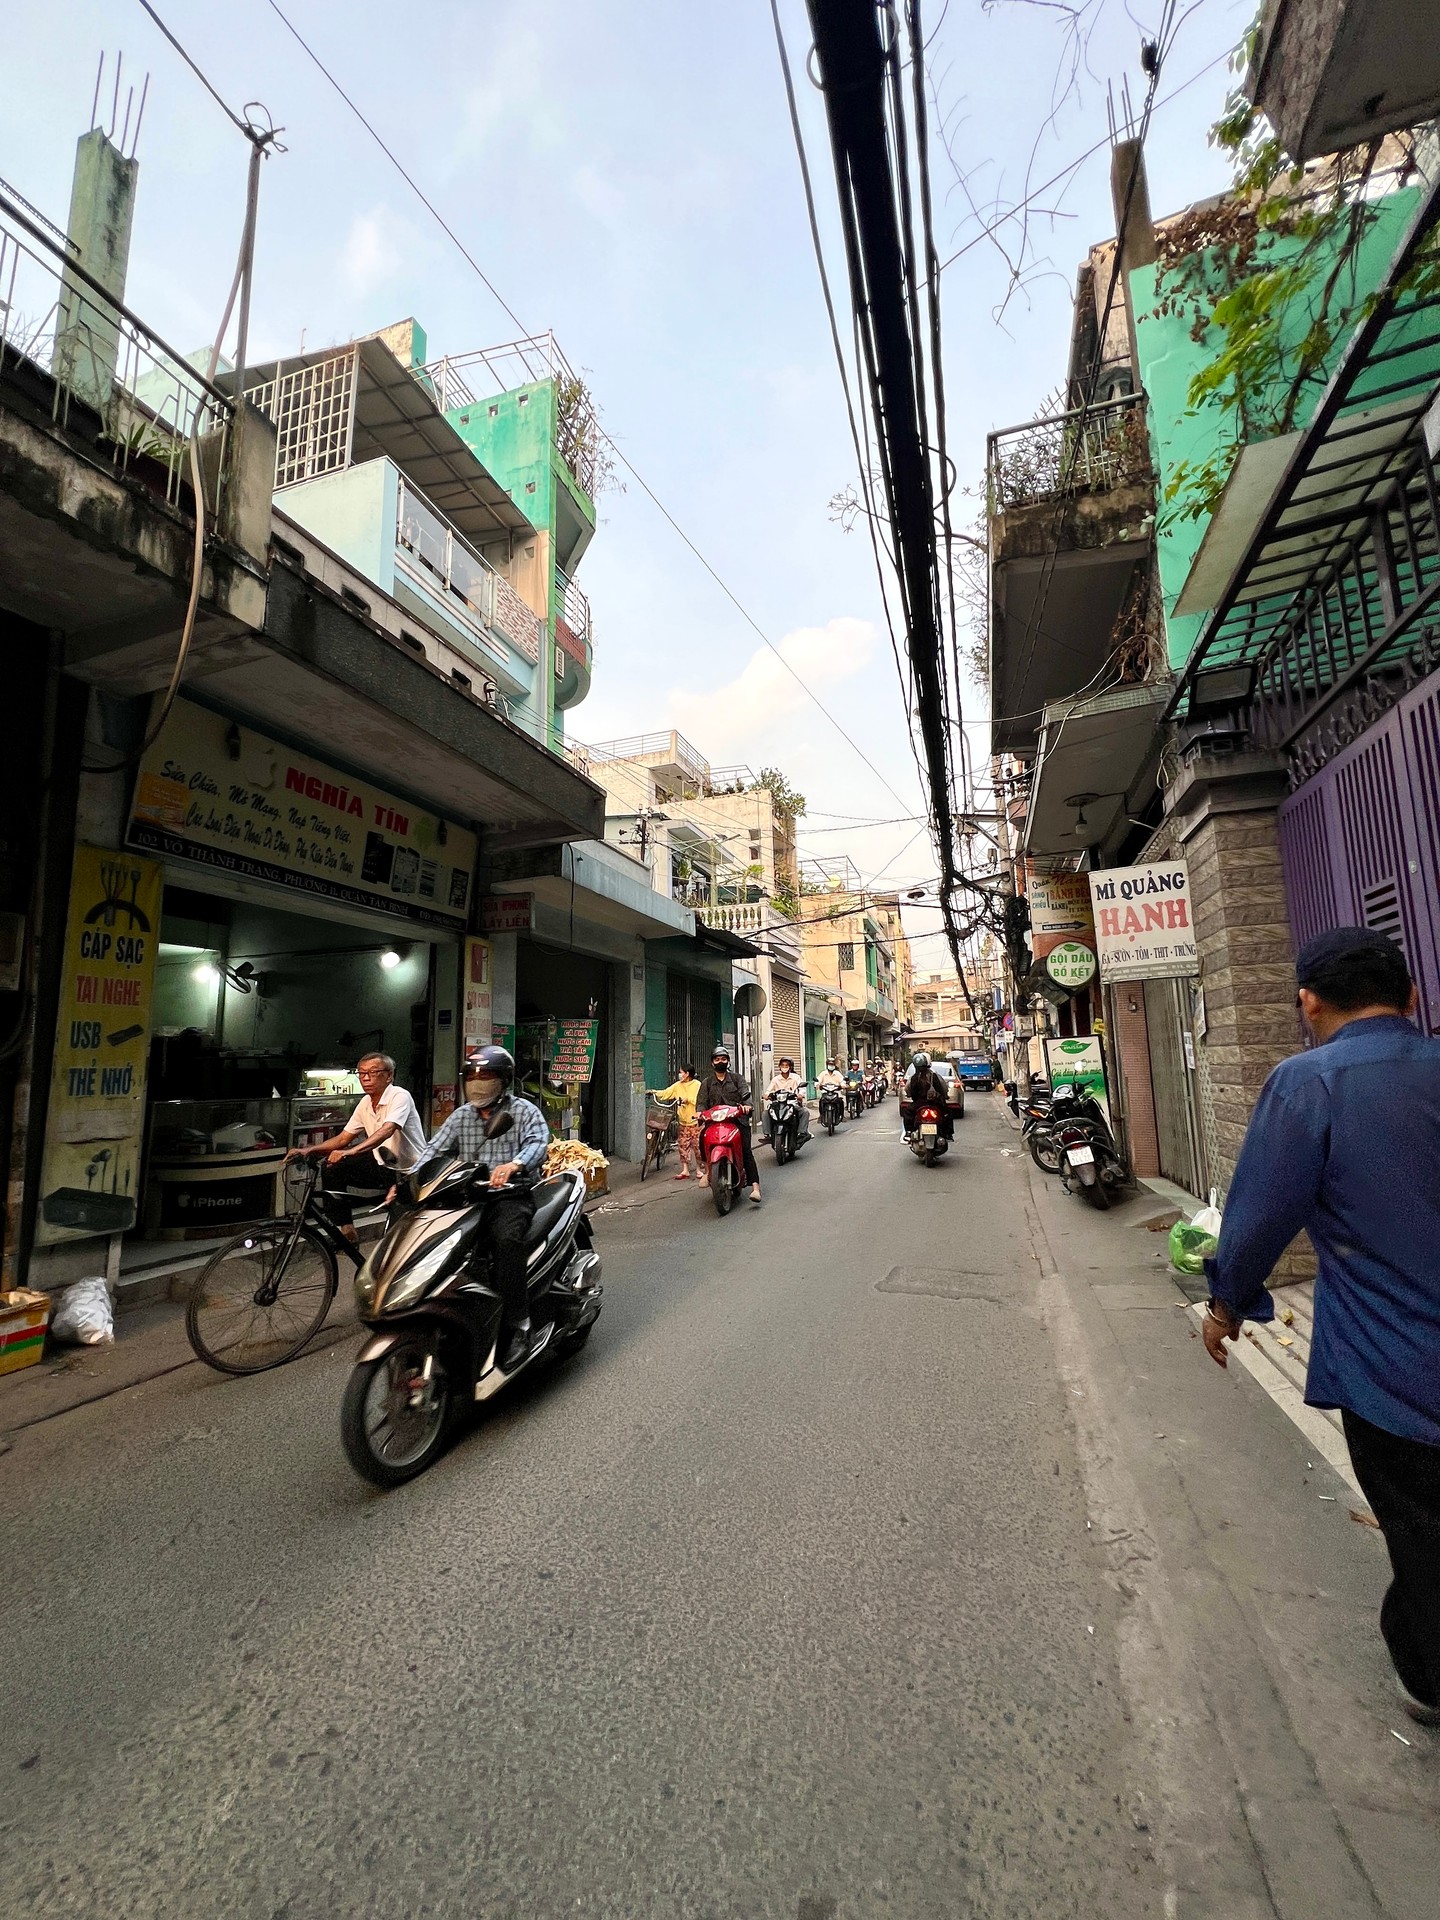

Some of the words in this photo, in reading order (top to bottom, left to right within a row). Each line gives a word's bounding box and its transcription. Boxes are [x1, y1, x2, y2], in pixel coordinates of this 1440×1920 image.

[285, 766, 363, 818] NGHĨA
[375, 804, 409, 835] TÍN
[137, 832, 159, 847] 102
[187, 845, 236, 869] THÀNH
[1095, 878, 1117, 901] MÌ
[1120, 869, 1186, 900] QUẢNG
[502, 899, 529, 911] IPHONE
[506, 912, 529, 928] LIỀN
[1099, 898, 1190, 942] HẠNH
[80, 927, 112, 960] CÁP
[115, 936, 144, 969] SẠC
[1153, 946, 1168, 961] THỊT
[1071, 965, 1091, 978] KẾT
[77, 975, 98, 1004] TAI
[102, 977, 141, 1006] NGHE
[70, 1020, 102, 1049] USB
[68, 1058, 97, 1096] THẺ
[101, 1061, 133, 1096] NHỚ
